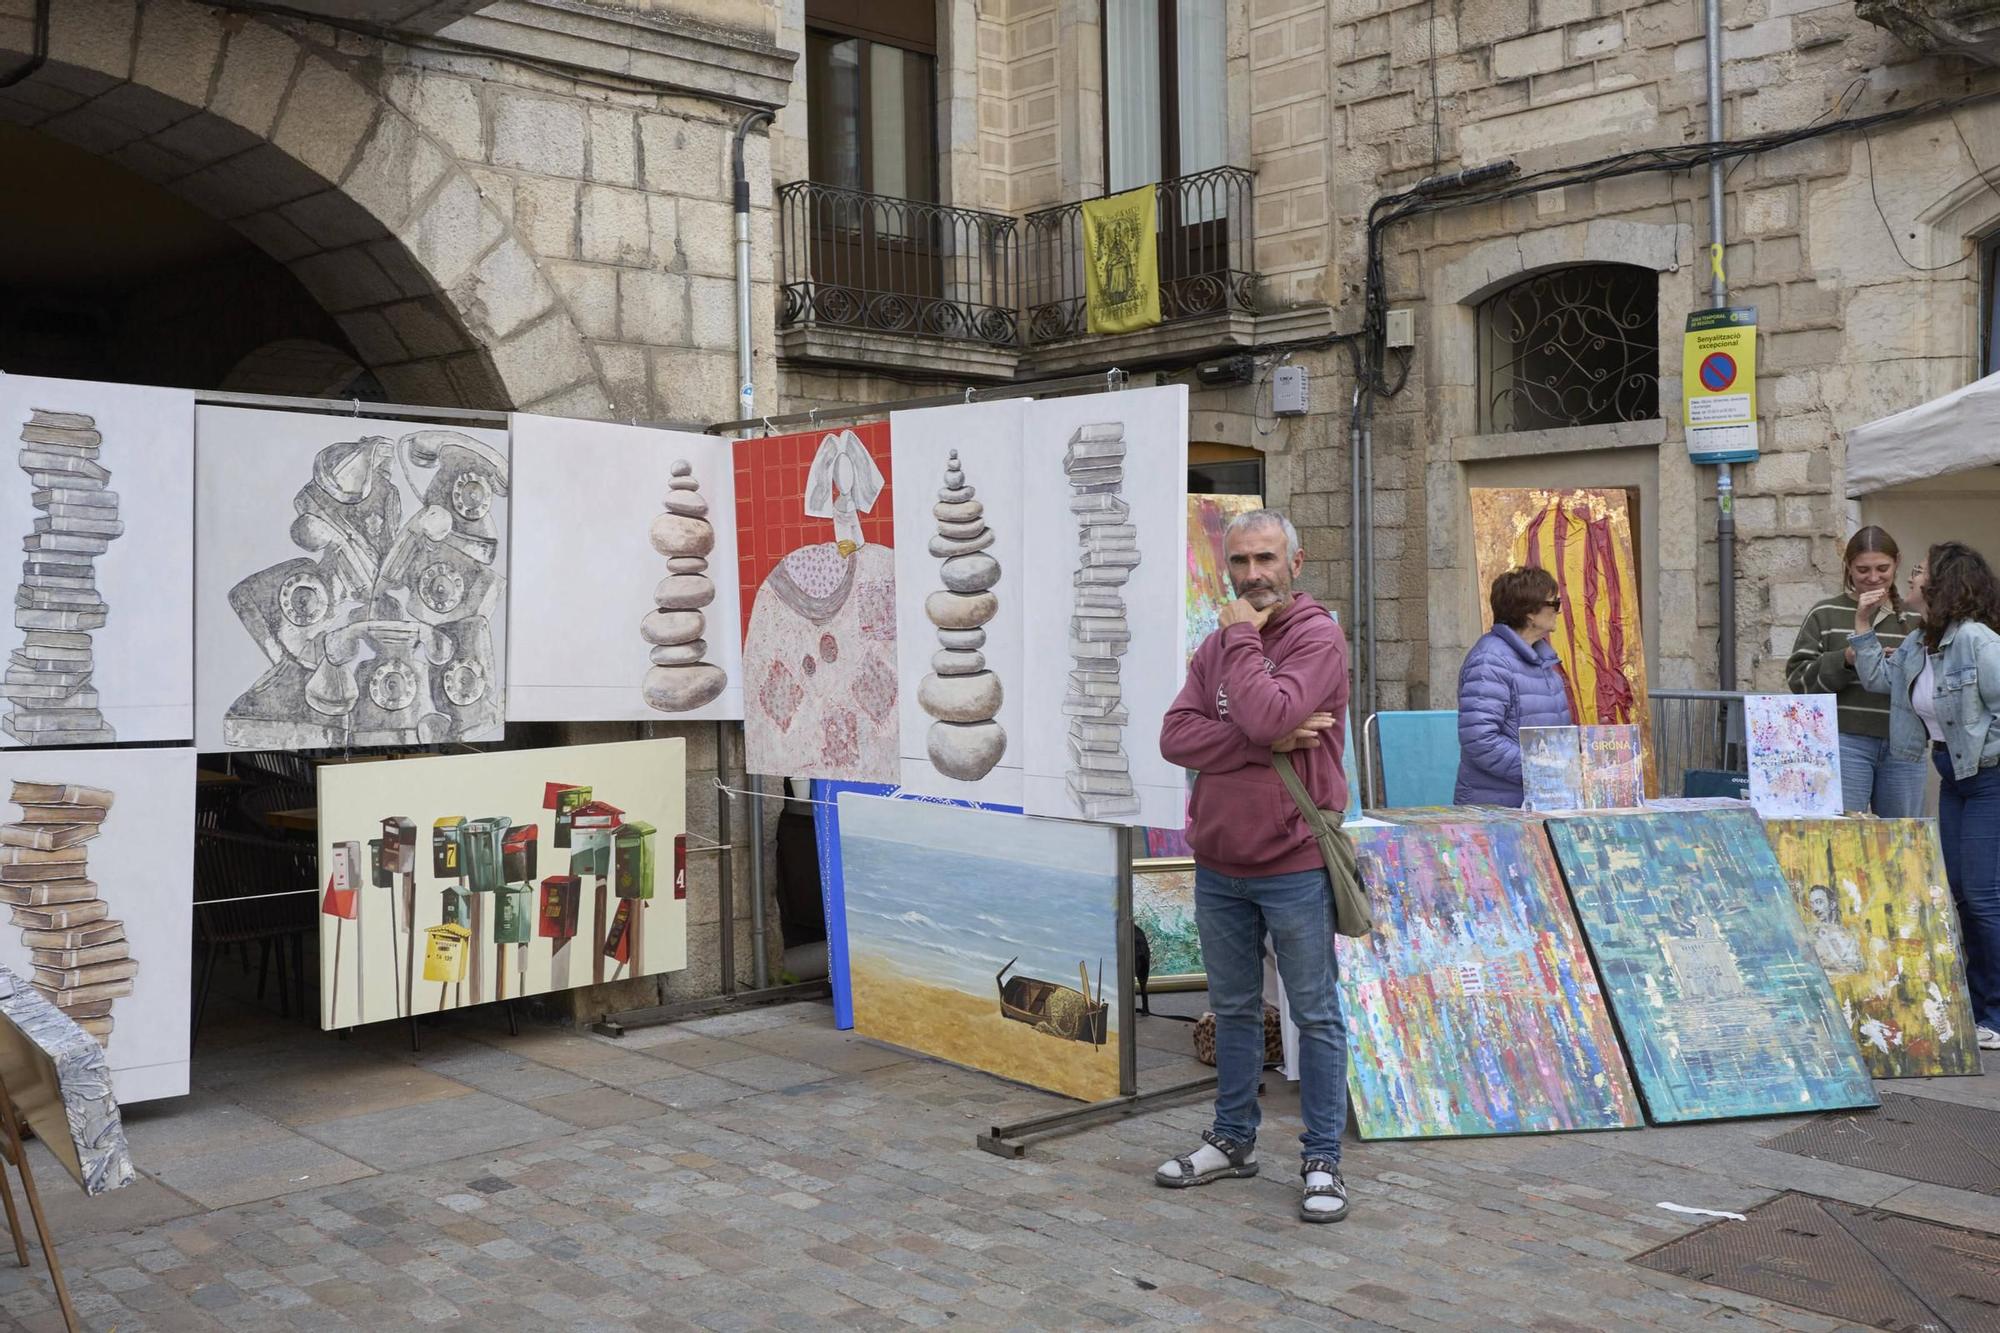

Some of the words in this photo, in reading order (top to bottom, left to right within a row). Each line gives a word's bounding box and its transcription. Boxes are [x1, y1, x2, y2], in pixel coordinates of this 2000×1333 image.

[1697, 333, 1741, 343] Senyalització
[1698, 340, 1739, 350] excepcional
[1591, 739, 1631, 751] GIRONA
[447, 847, 455, 866] 7
[676, 868, 685, 889] 4
